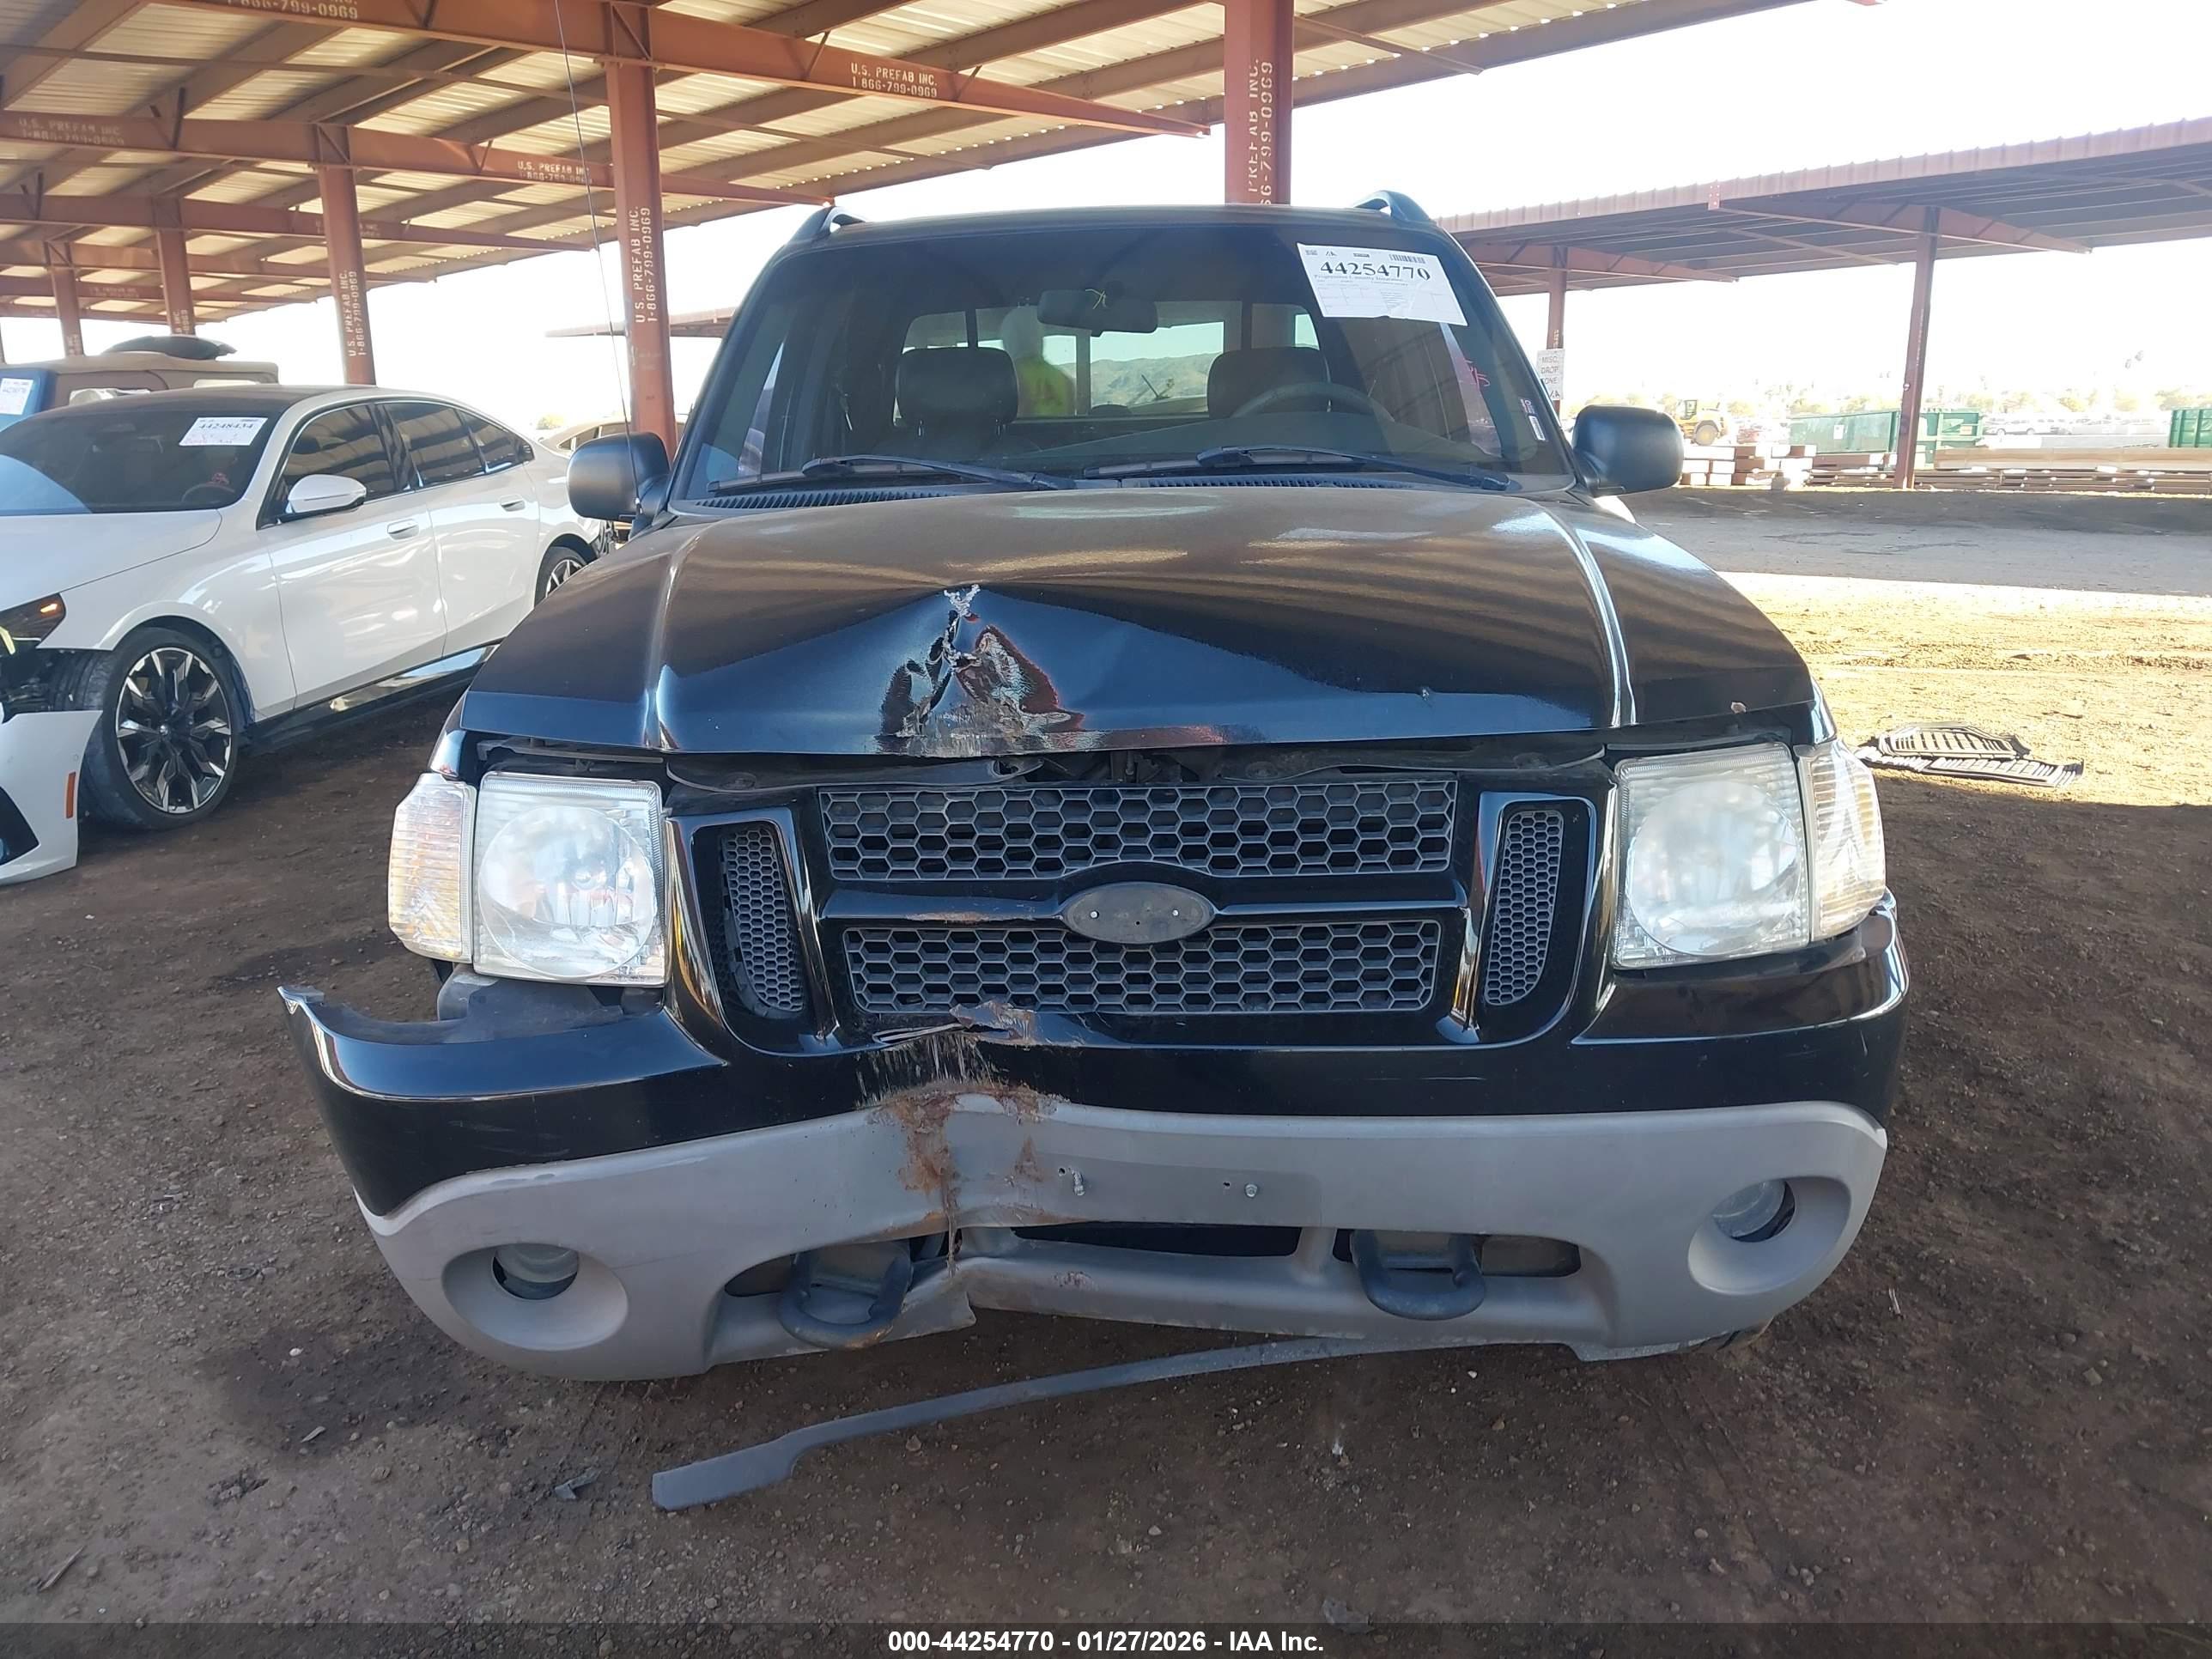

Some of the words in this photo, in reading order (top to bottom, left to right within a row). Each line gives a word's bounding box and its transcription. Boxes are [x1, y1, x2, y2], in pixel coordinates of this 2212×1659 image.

[851, 63, 871, 76] U.S.
[876, 67, 915, 82] PREFAB
[919, 73, 937, 85] INC.
[517, 161, 535, 171] U.S.
[539, 163, 572, 173] PREFAB
[629, 206, 640, 231] INC.
[631, 238, 643, 290] PREFAB
[640, 207, 658, 323] 1-866-799-0969
[1320, 261, 1431, 281] 44254770
[339, 270, 349, 289] INC.
[342, 294, 354, 333] PREFAB
[1540, 366, 1559, 374] DROP
